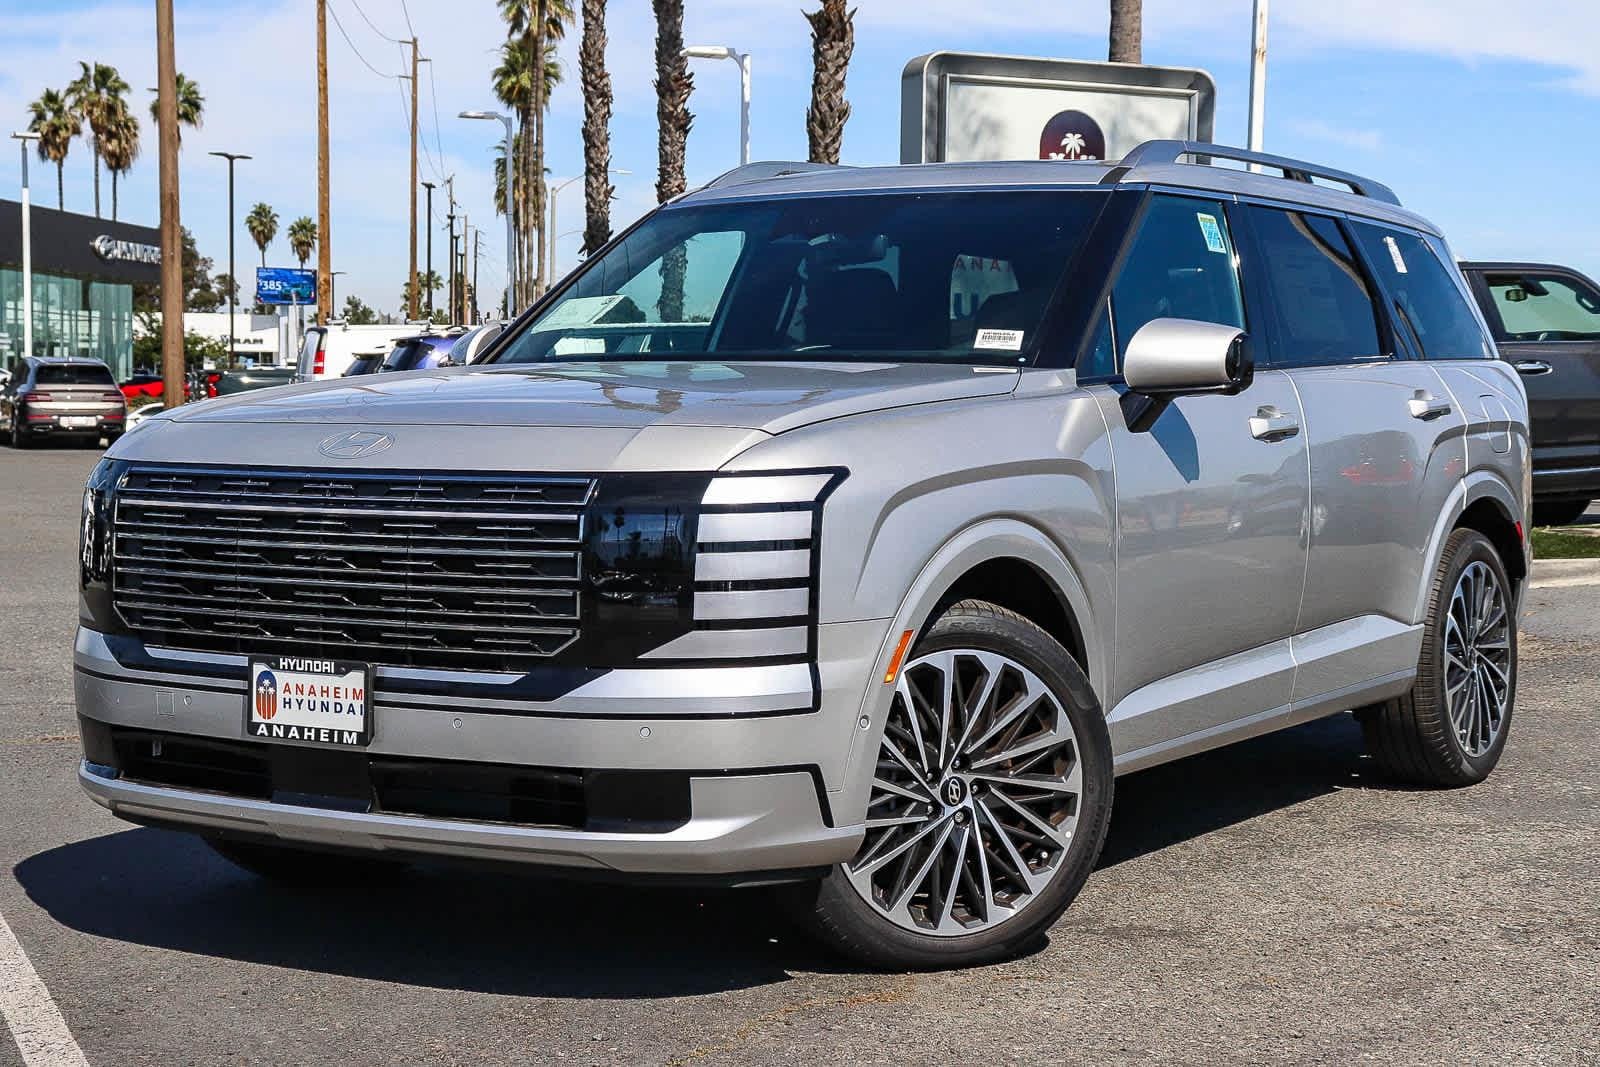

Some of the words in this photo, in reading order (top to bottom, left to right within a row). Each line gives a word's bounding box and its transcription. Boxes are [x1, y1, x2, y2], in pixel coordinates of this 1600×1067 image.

[279, 657, 335, 674] HYUNDAI
[282, 682, 364, 701] ANAHEIM
[282, 697, 364, 716] HYUNDAI
[256, 723, 358, 745] ANAHEIM
